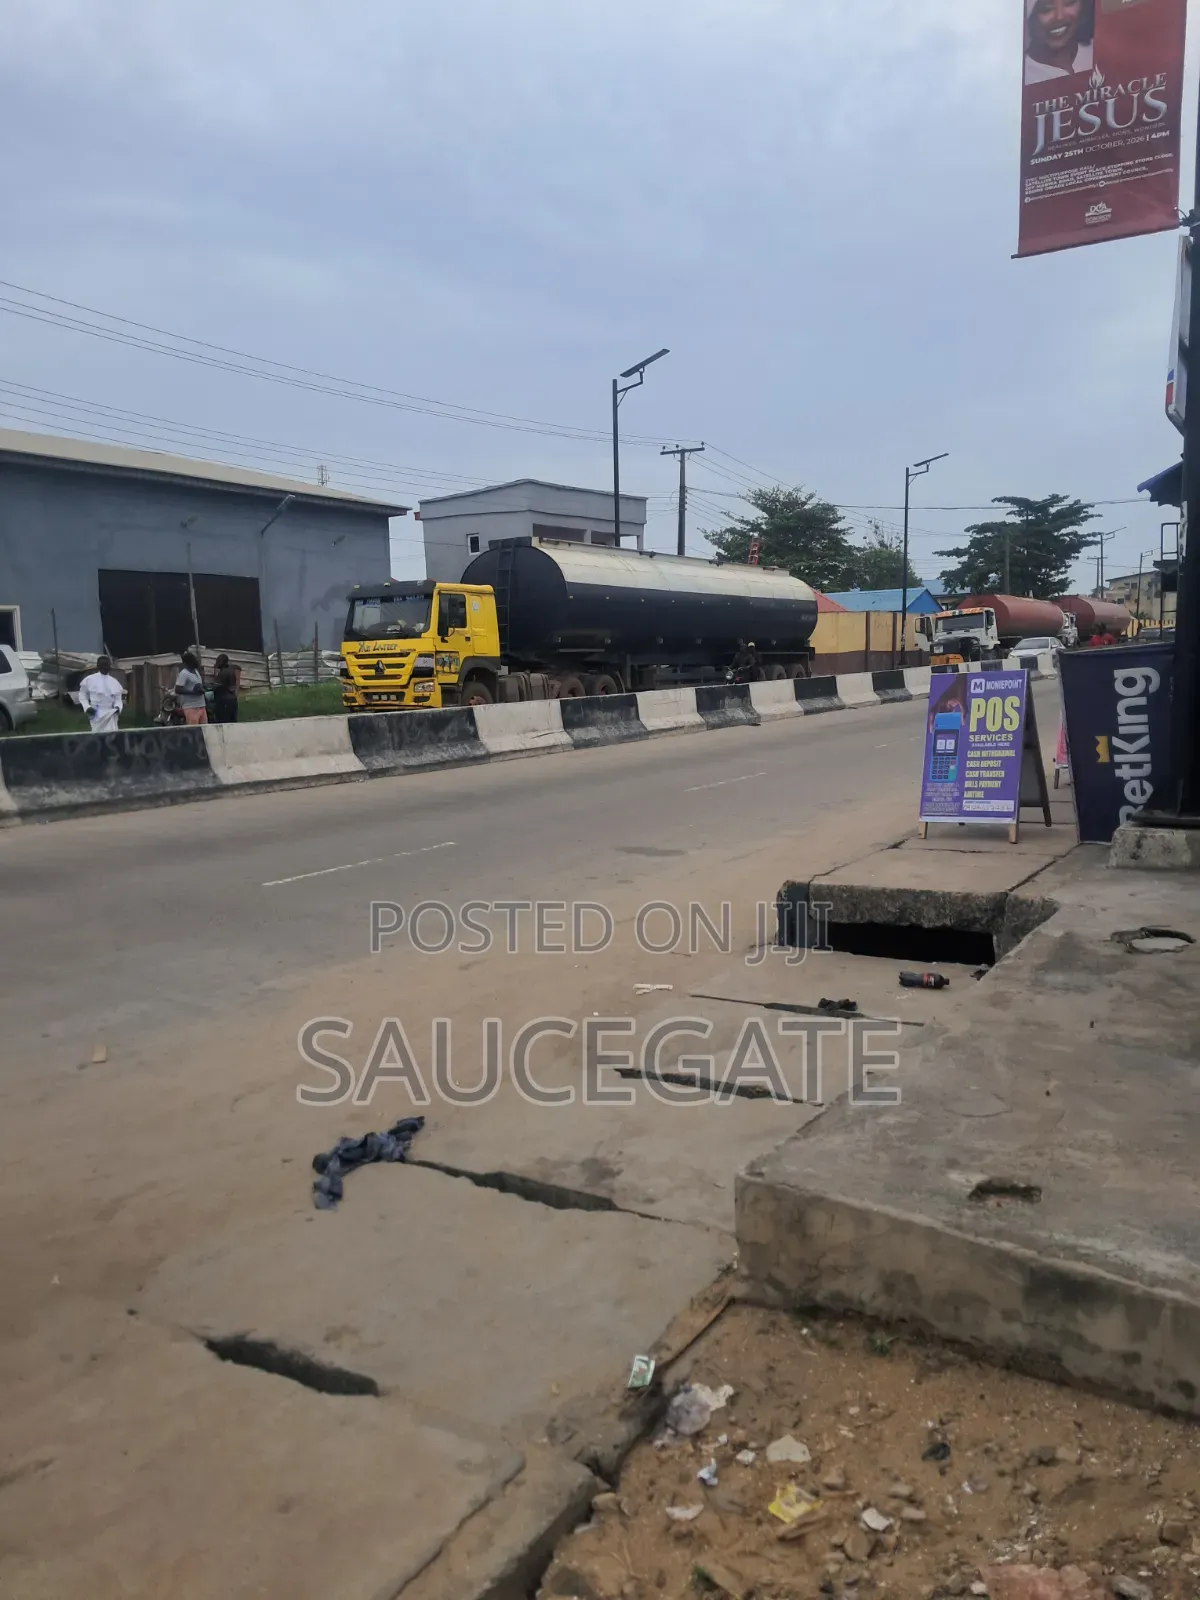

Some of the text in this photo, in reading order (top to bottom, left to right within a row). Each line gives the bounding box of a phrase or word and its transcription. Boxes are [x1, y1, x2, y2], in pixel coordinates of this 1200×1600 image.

[1032, 72, 1168, 116] THE MIRACLE
[1032, 86, 1168, 156] JESUS
[1030, 153, 1063, 165] SUNDAY
[1063, 147, 1084, 158] 25TH
[1085, 139, 1126, 153] OCTOBER,
[1150, 130, 1170, 139] 4PM
[986, 679, 1022, 690] MONIEPOINT
[969, 696, 1020, 732] POS
[969, 734, 1013, 742] SERVICES
